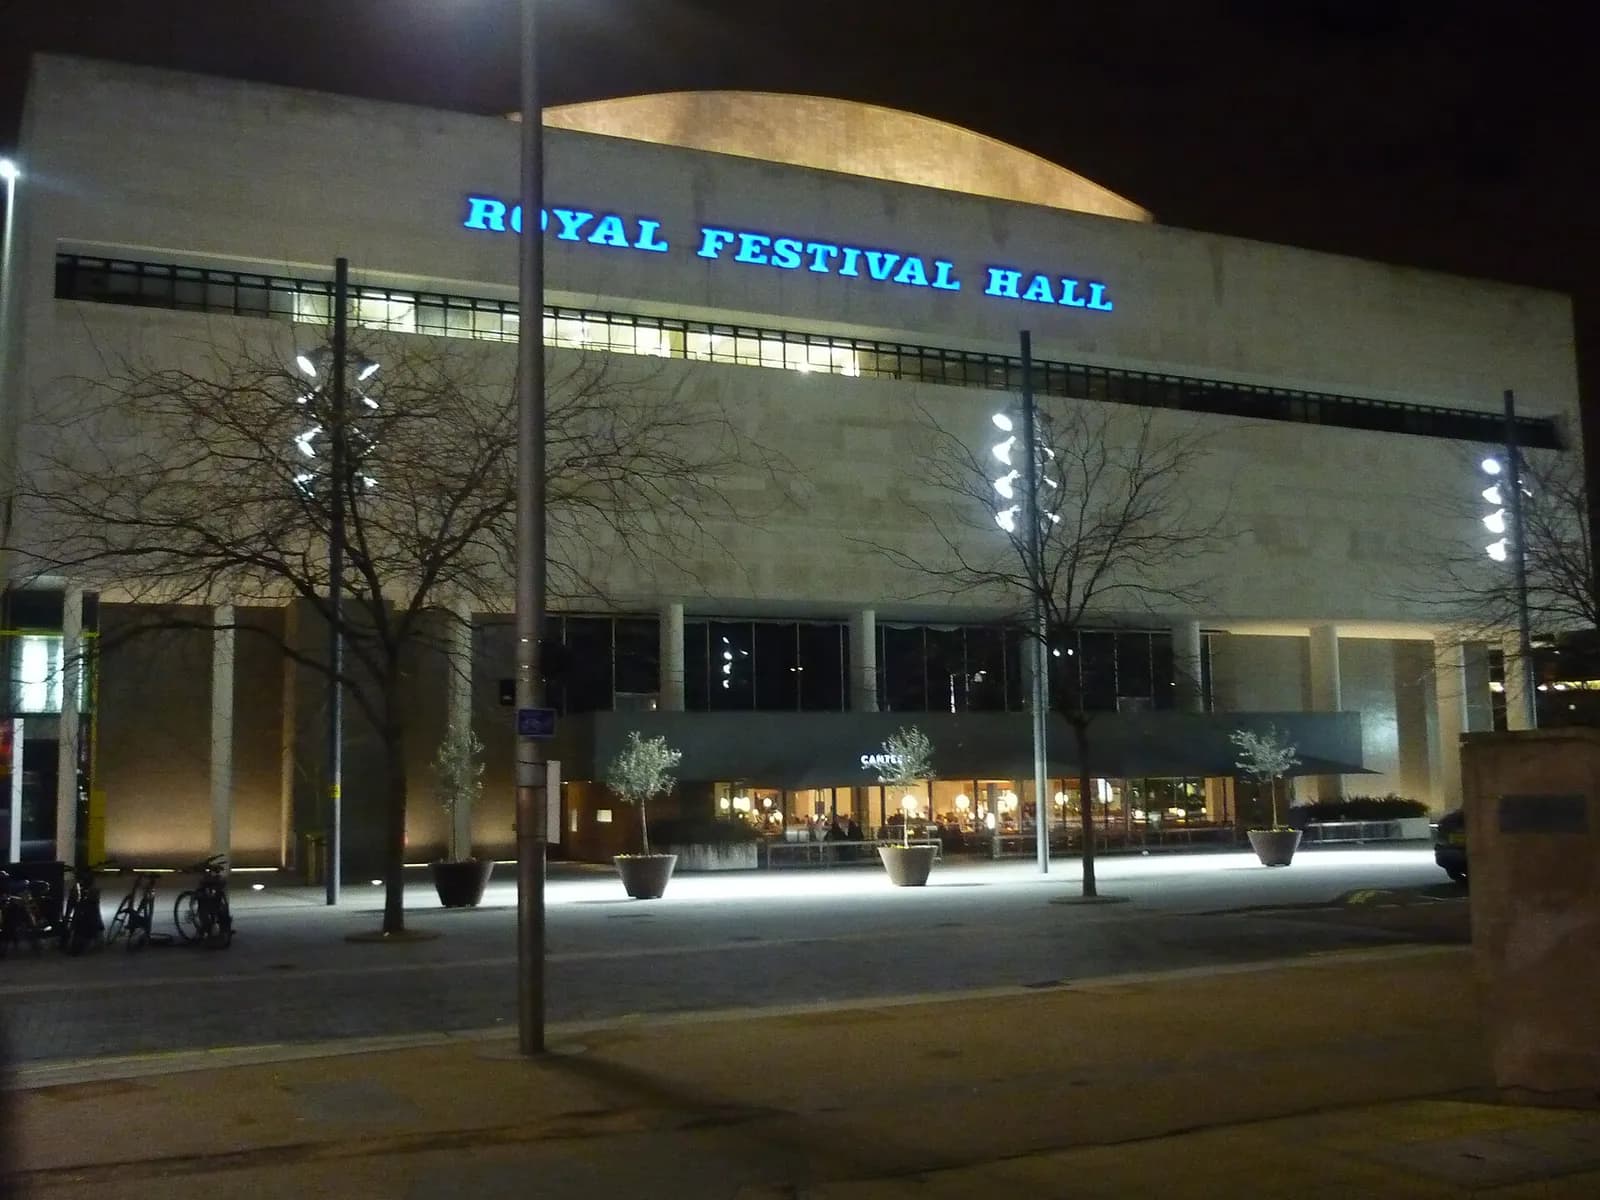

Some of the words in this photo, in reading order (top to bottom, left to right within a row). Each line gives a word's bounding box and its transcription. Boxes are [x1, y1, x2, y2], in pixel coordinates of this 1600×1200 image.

[463, 196, 670, 253] ROYAL
[696, 227, 962, 292] FESTIVAL
[983, 267, 1114, 312] HALL
[860, 753, 911, 765] CANTEE
